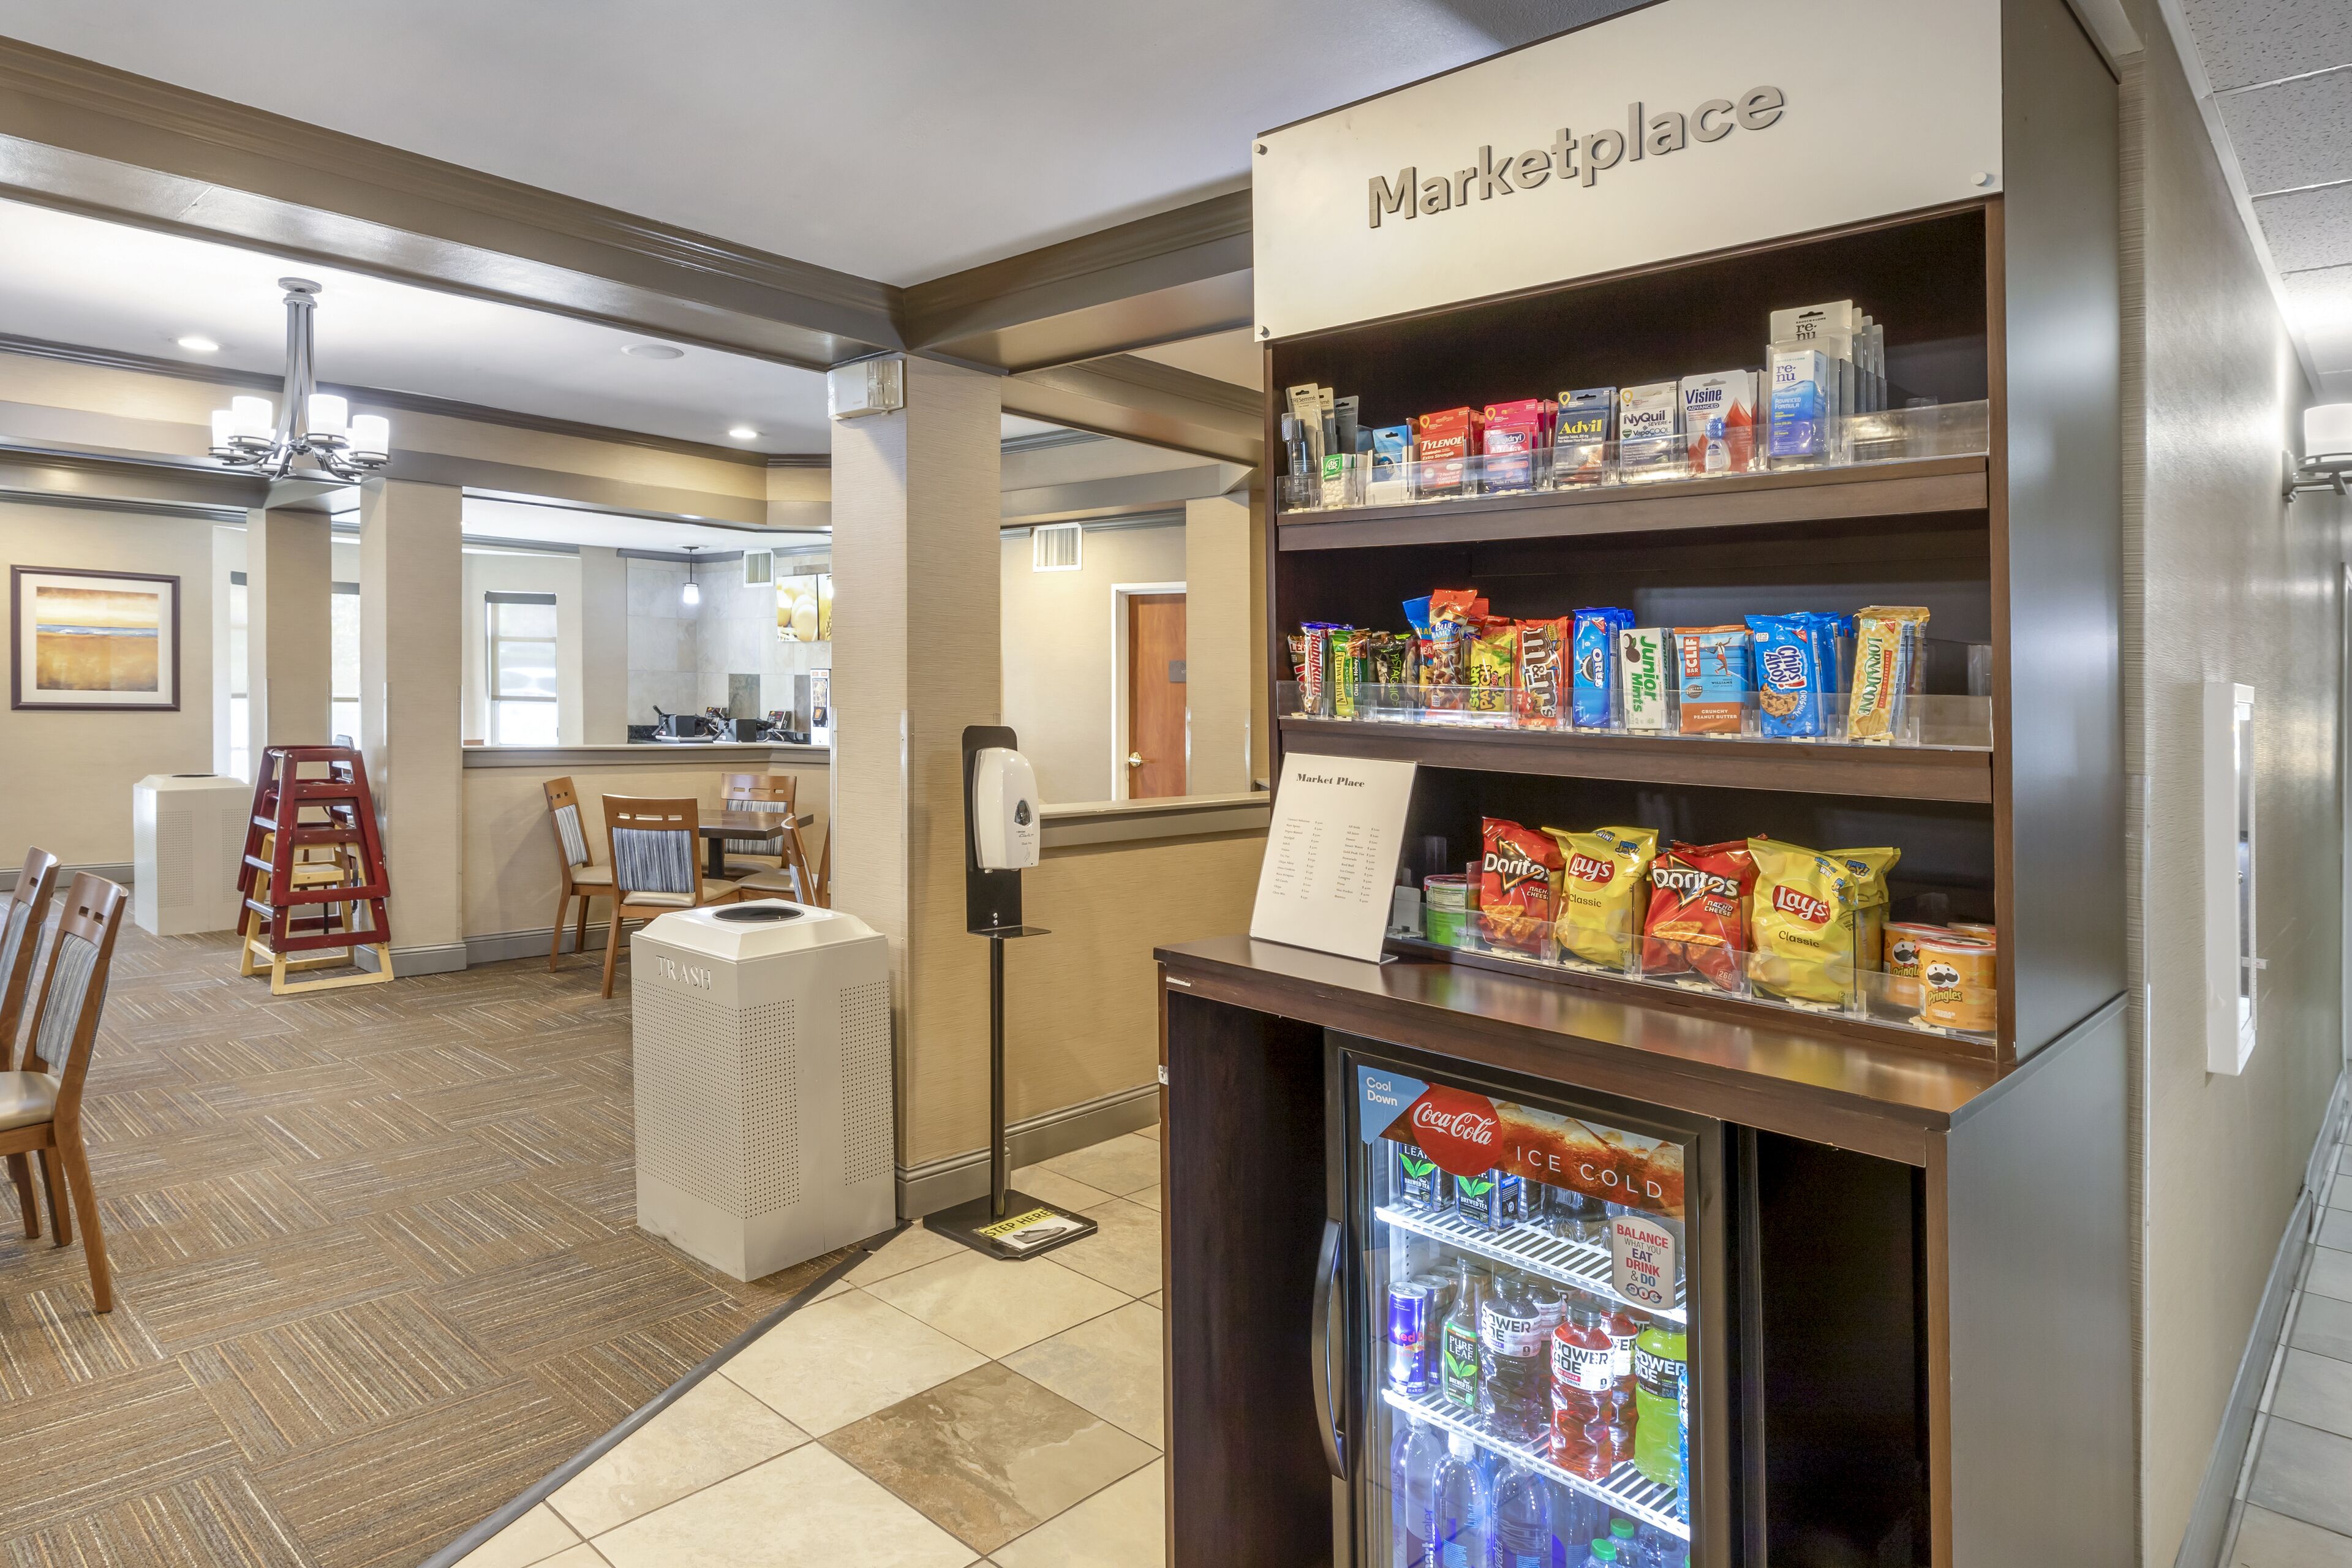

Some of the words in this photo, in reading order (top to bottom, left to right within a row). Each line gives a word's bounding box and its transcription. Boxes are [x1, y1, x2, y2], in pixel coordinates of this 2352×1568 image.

[1368, 85, 1787, 229] Marketplace
[1776, 373, 1796, 382] nu
[1686, 388, 1722, 404] Visine
[1559, 419, 1602, 434] Advil
[1624, 410, 1665, 426] NyQuil
[1633, 428, 1671, 436] VapoCOOL
[1422, 435, 1463, 451] TYLENOL
[1435, 622, 1454, 631] BLUE
[1686, 638, 1698, 668] CLIF
[1864, 636, 1883, 676] LORNA
[1591, 647, 1603, 688] OREO
[1640, 636, 1659, 701] Junior
[1777, 646, 1801, 681] Chips
[1336, 677, 1346, 703] NATURE
[1469, 666, 1480, 708] SOUR
[1480, 664, 1492, 710] PATCH
[1631, 673, 1643, 712] Mints
[1858, 676, 1882, 715] DOONE
[1793, 690, 1807, 717] ORIGINAL
[1296, 773, 1333, 785] Market
[1336, 776, 1365, 788] Place
[1569, 854, 1612, 882] Lay's
[1653, 869, 1739, 897] Doritos
[1526, 891, 1548, 900] CHEES
[1569, 894, 1602, 908] Classic
[1704, 906, 1733, 917] CHEESE
[1707, 900, 1733, 911] NACHO
[1778, 930, 1820, 948] Classic
[655, 955, 711, 990] TRASH
[1928, 988, 1963, 1006] Pringles
[1366, 1077, 1392, 1092] Cool
[1367, 1090, 1398, 1106] Down
[1413, 1102, 1497, 1145] Coca-Cola
[1517, 1146, 1561, 1172] ICE
[1580, 1164, 1662, 1198] COLD
[1404, 1178, 1422, 1188] BREWED
[1460, 1196, 1479, 1207] BREWED
[984, 1223, 1016, 1237] STEP
[1017, 1210, 1053, 1225] HERE
[1617, 1224, 1668, 1249] BALANCE
[1624, 1237, 1645, 1250] WHAT
[1646, 1244, 1661, 1255] YOU
[1626, 1257, 1660, 1278] DRINK
[1630, 1270, 1638, 1282] &
[1640, 1273, 1656, 1287] DO
[1449, 1335, 1474, 1352] PURE
[1449, 1376, 1466, 1388] BREWED
